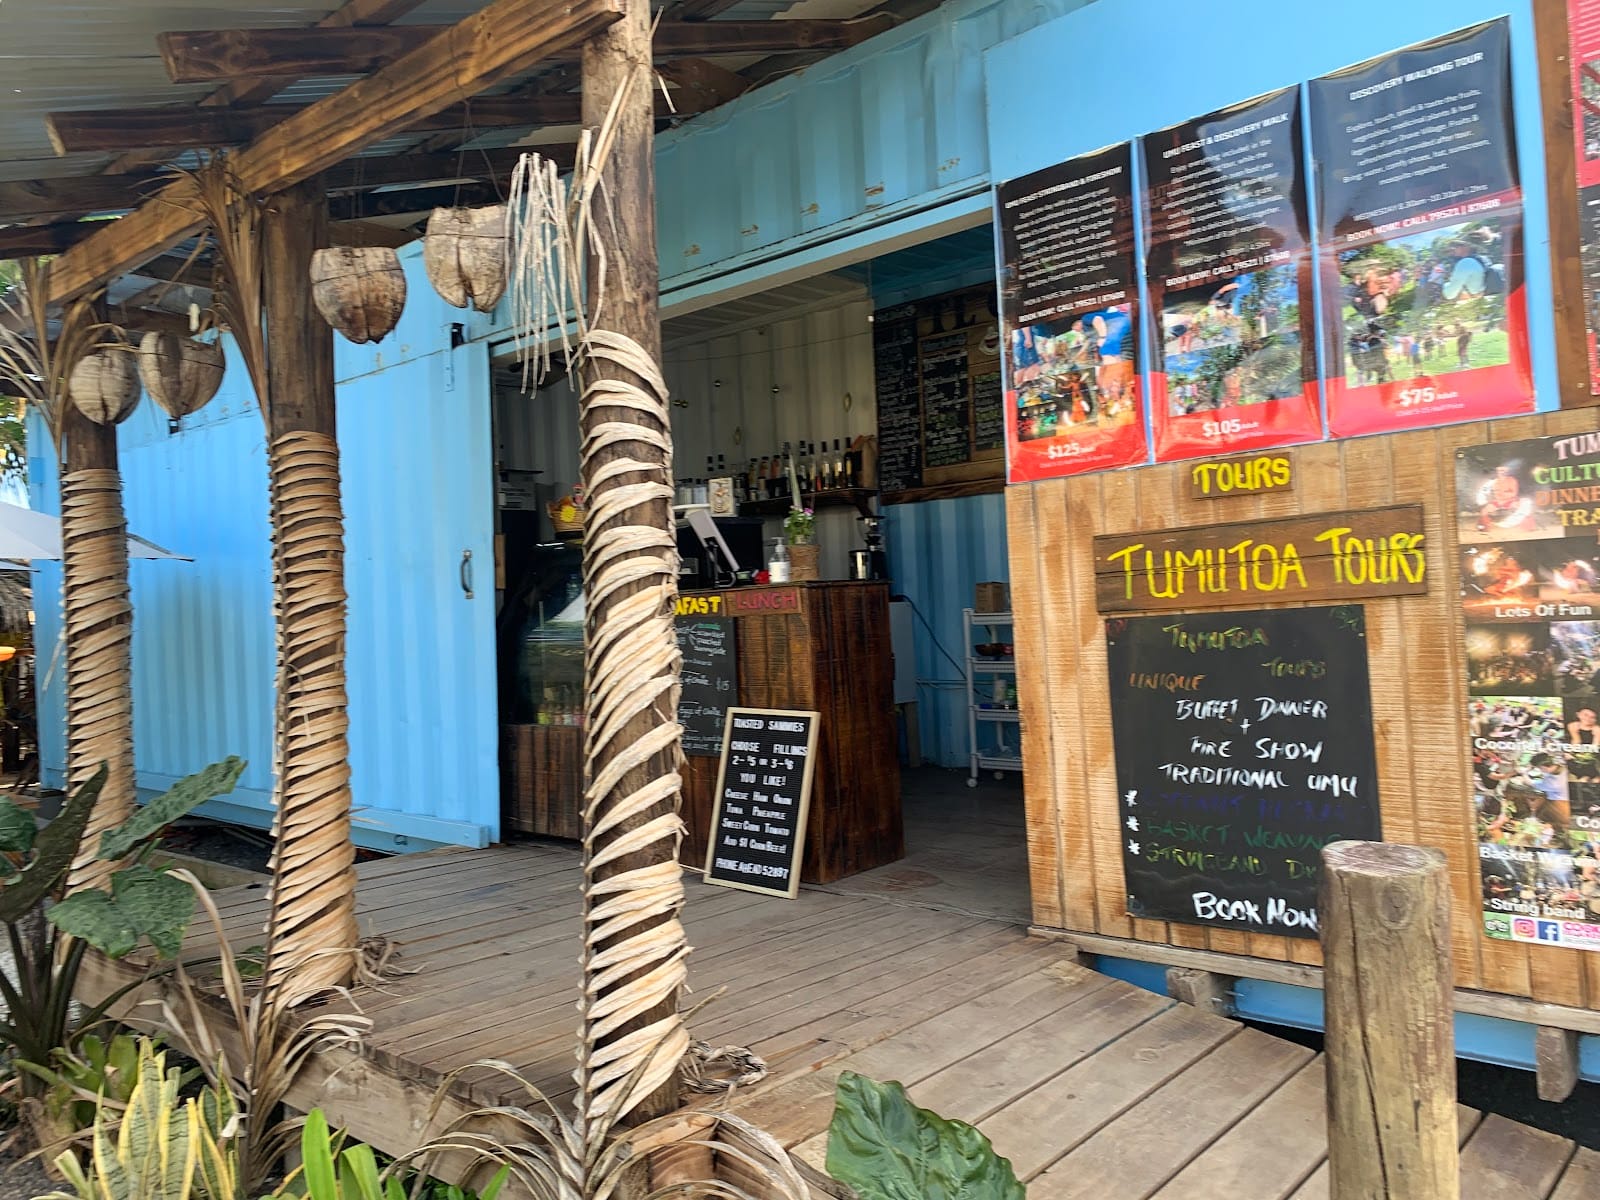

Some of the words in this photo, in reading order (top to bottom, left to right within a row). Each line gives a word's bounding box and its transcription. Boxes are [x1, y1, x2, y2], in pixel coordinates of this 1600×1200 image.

[1350, 76, 1402, 100] DISCOVERY
[1405, 61, 1454, 83] WALKING
[1455, 52, 1483, 68] TOUR
[1162, 147, 1180, 158] UMU
[1181, 139, 1204, 153] FEAST
[1214, 121, 1262, 142] DISCOVERY
[1262, 113, 1288, 128] WALK
[1346, 228, 1372, 242] BOOK
[1402, 215, 1428, 229] CALL
[1166, 274, 1188, 286] BOOK
[1212, 264, 1232, 276] CALL
[1399, 387, 1435, 407] $75
[1202, 418, 1241, 438] $105
[1048, 442, 1080, 459] $125
[1193, 456, 1290, 494] TOURS
[1107, 540, 1308, 600] TUMUTOA
[1314, 527, 1426, 586] TOURS
[736, 592, 796, 609] LUNCH
[1495, 606, 1531, 618] Lots
[1535, 604, 1555, 616] Of
[1559, 604, 1592, 616] Fun
[1129, 672, 1207, 694] UNIQUE
[1176, 698, 1239, 721] BUFFET
[1255, 697, 1328, 722] DINNER
[734, 718, 764, 730] TOASTED
[731, 741, 760, 752] CHOOSE
[772, 744, 808, 756] FILLINGS
[1191, 736, 1233, 758] FIRE
[1255, 737, 1324, 764] SHOW
[1474, 737, 1542, 752] Coconut
[740, 773, 756, 784] YOU
[762, 775, 786, 786] LIKE!
[1158, 763, 1291, 790] TRADITIONAL
[1307, 774, 1359, 798] UMU
[1480, 846, 1534, 862] Basket
[716, 858, 740, 872] PHONE
[738, 862, 762, 874] AHEAD
[1192, 892, 1262, 925] BOOK
[1490, 898, 1540, 917] String
[1543, 904, 1586, 920] band
